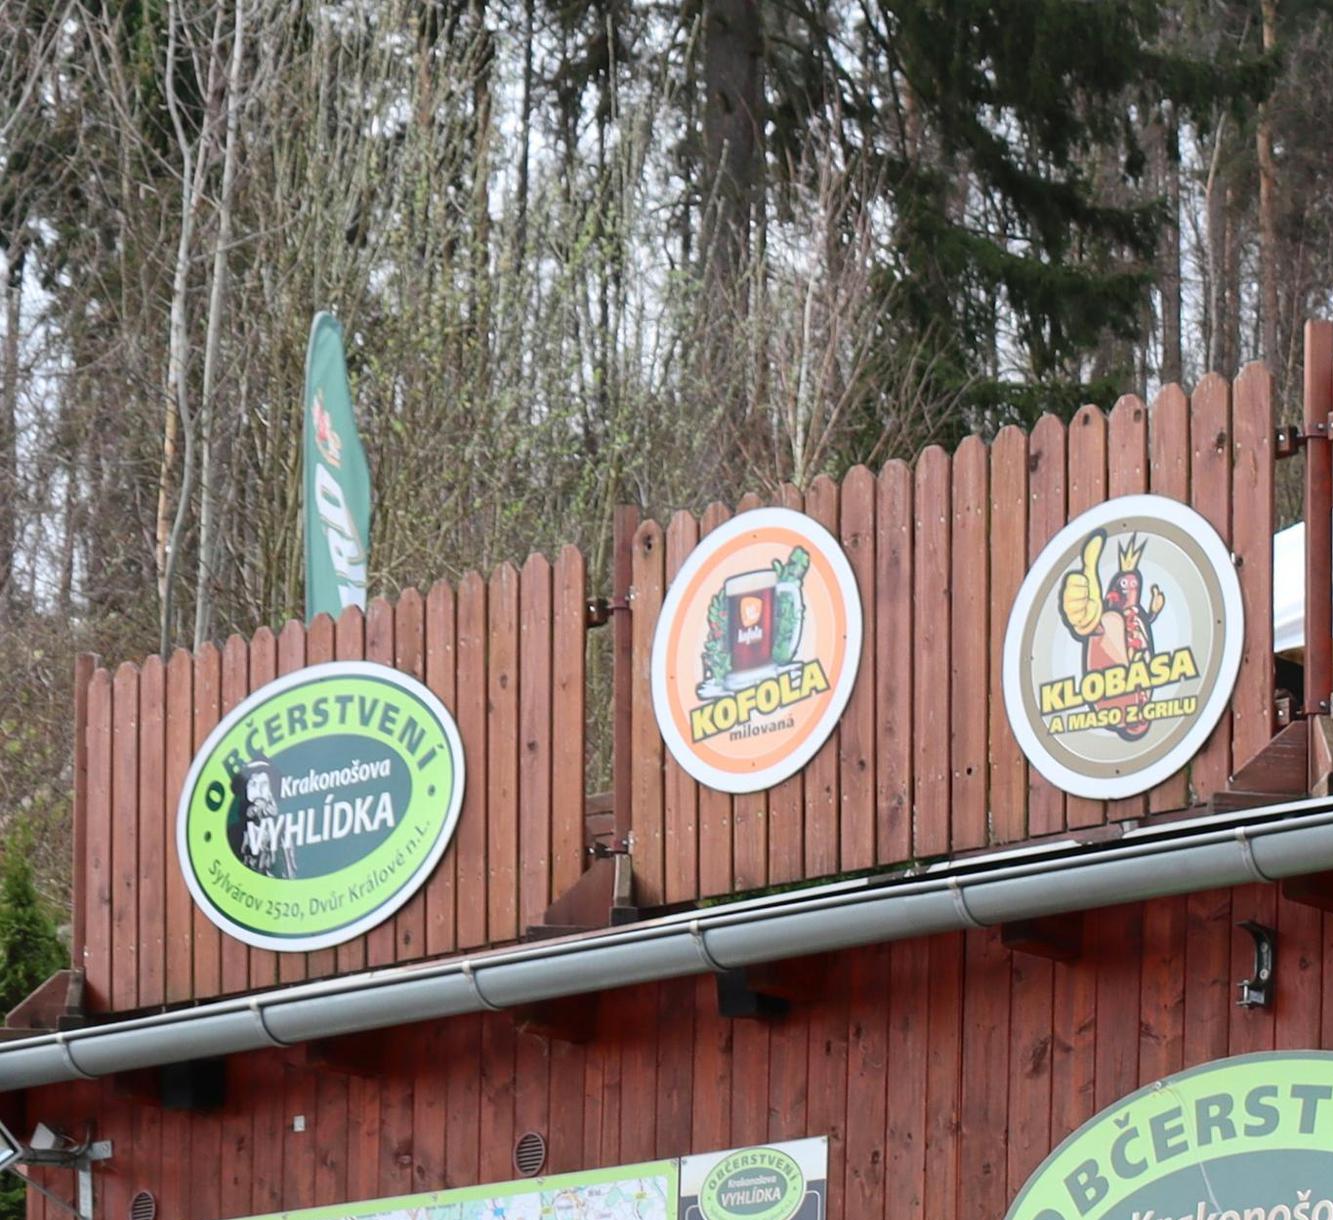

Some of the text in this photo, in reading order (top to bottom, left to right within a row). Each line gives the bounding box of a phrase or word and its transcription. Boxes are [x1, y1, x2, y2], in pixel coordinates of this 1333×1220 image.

[690, 659, 830, 743] KOFOLA
[1040, 646, 1200, 715] KLOBÁSA
[729, 713, 795, 741] milovaná
[1049, 696, 1198, 736] A MASO Z GRILU
[205, 694, 444, 812] OBČERSTVENÍ
[281, 759, 391, 798] Krakonošova
[248, 792, 395, 855] VYHLÍDKA
[208, 859, 264, 912] Sylvárov
[309, 891, 345, 917] Dvůr
[349, 848, 405, 903] Králové
[721, 1187, 781, 1207] VYHLÍDKA
